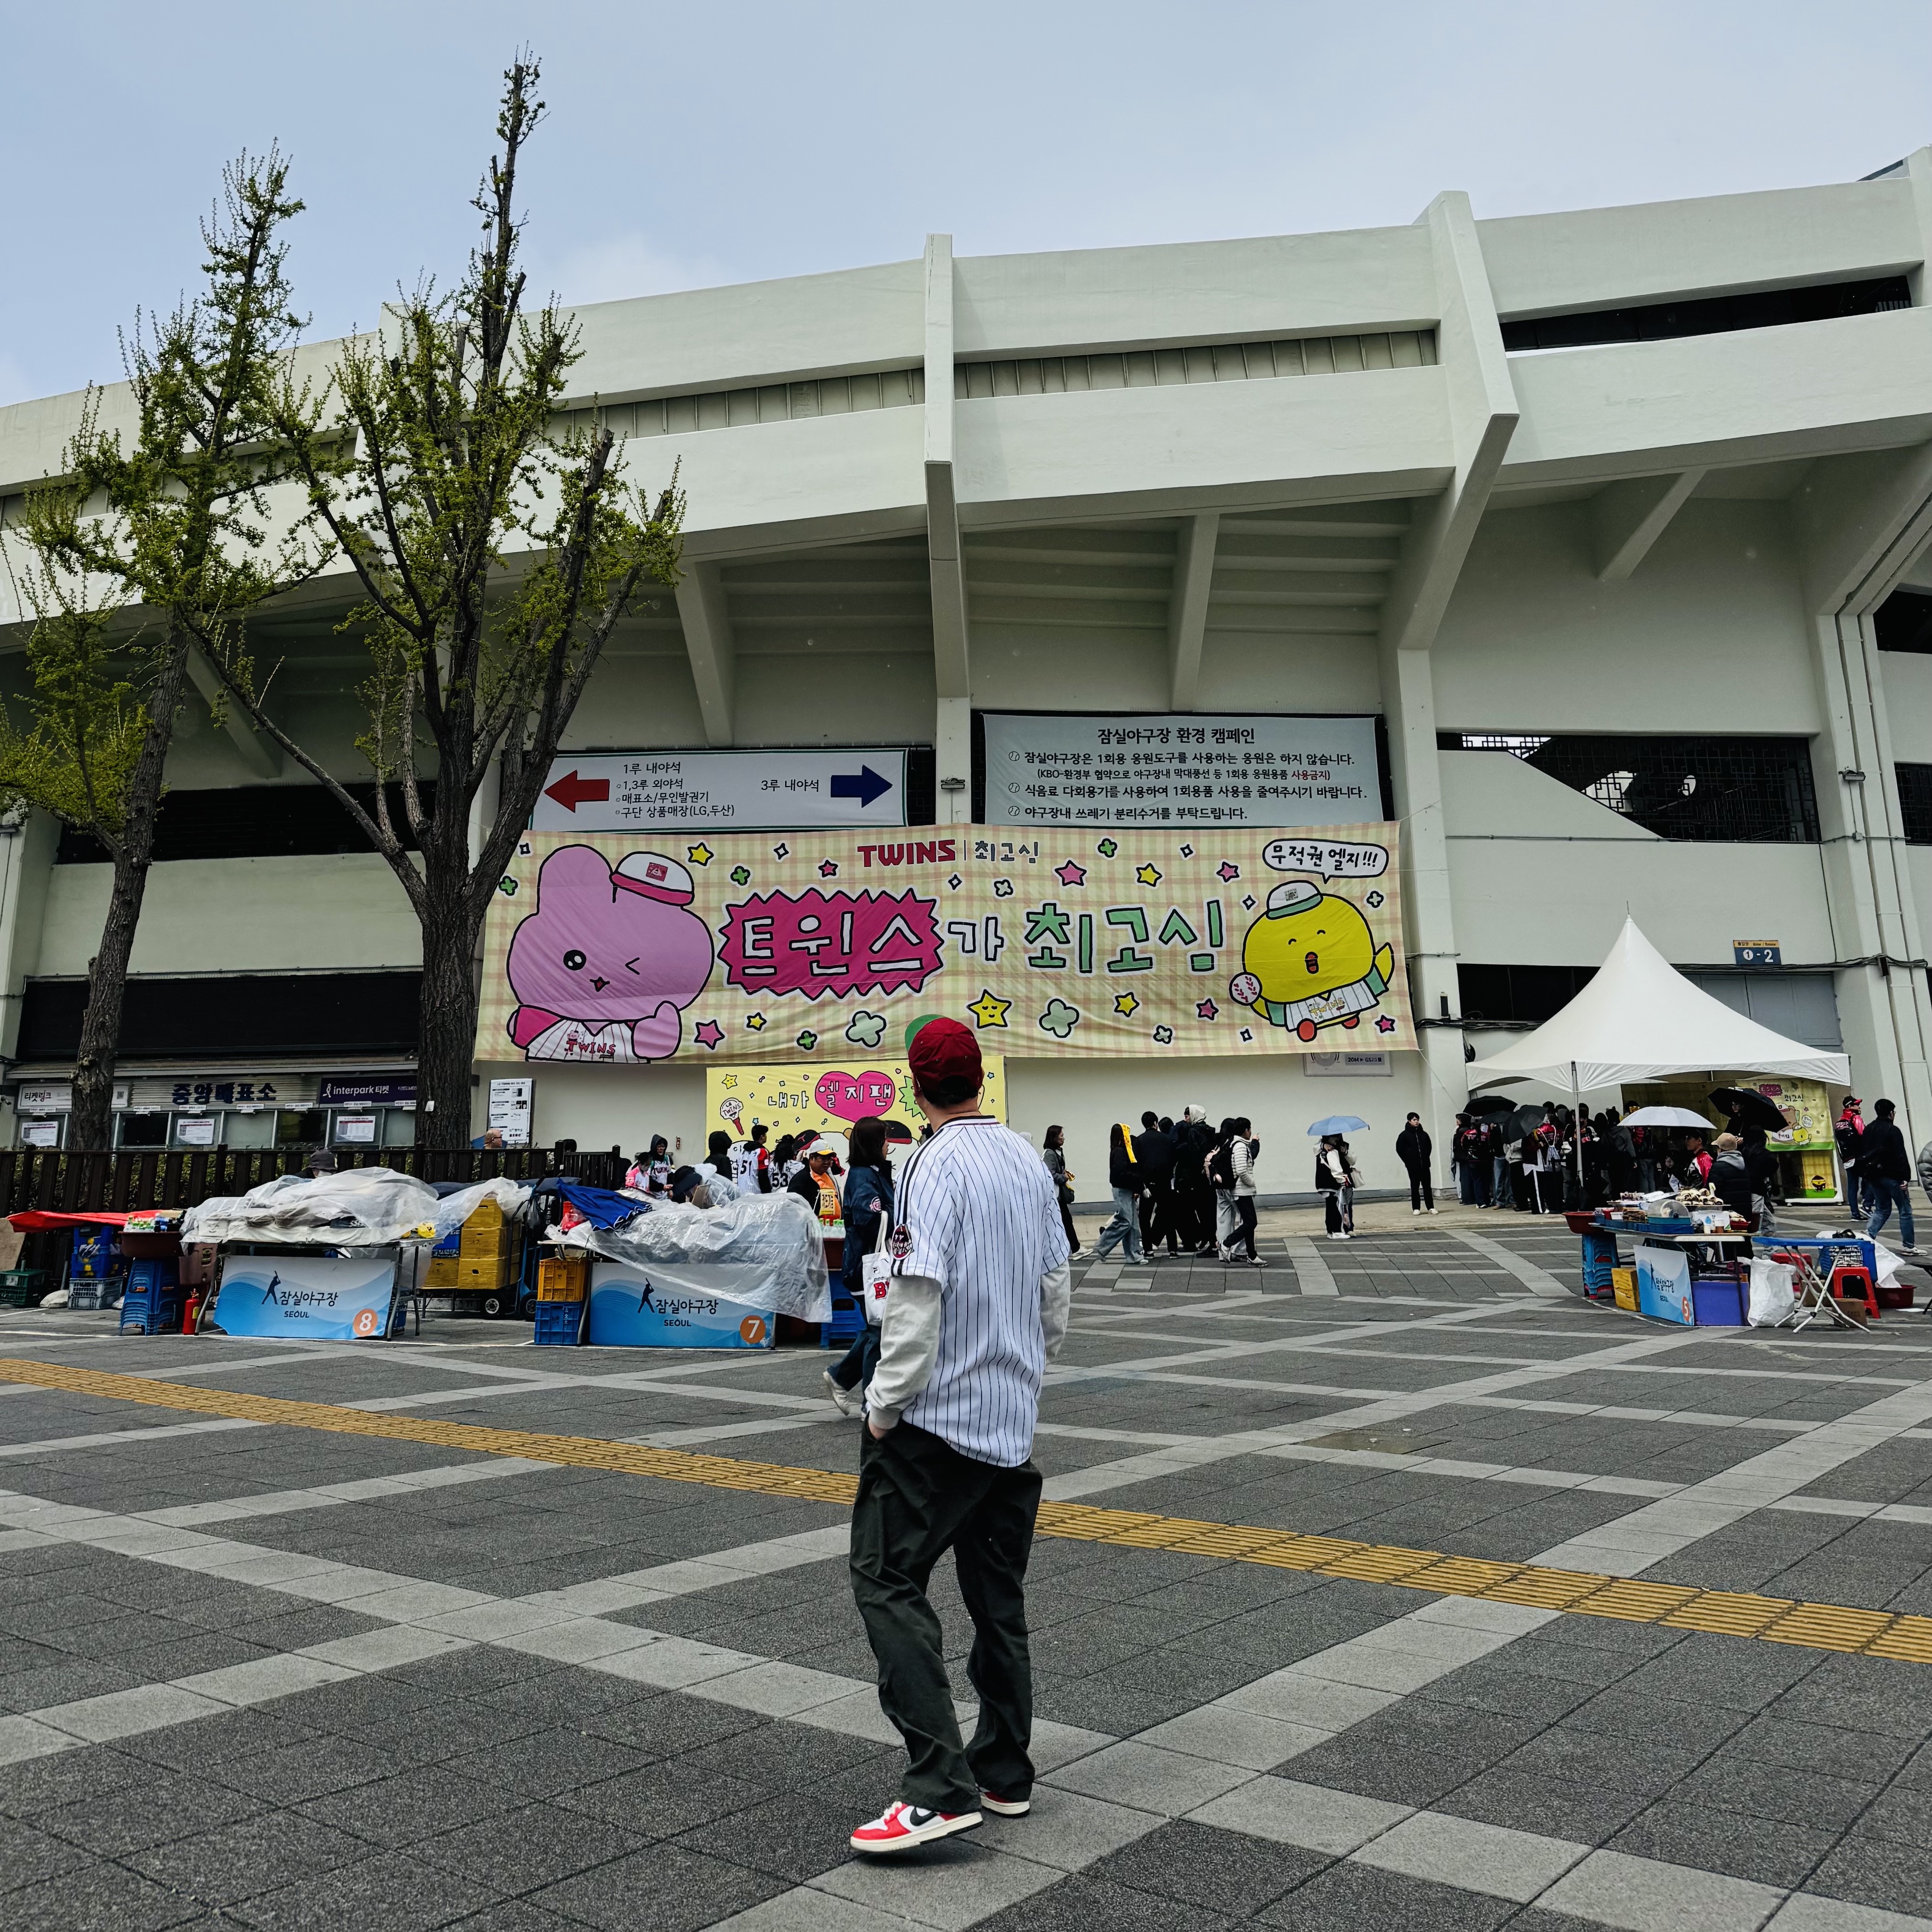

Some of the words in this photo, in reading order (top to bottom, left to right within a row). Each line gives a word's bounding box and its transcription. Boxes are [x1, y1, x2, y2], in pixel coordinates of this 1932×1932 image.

[1098, 728, 1171, 745] 잠실야구장
[1177, 728, 1205, 744] 환경
[1211, 728, 1255, 744] 캠페인
[1025, 752, 1093, 765] 잠실야구장은
[1098, 752, 1126, 765] 1회용
[1131, 752, 1188, 765] 응원도구를
[1192, 752, 1238, 765] 사용하는
[1242, 752, 1276, 765] 응원은
[1280, 753, 1301, 765] 하지
[1307, 753, 1354, 765] 않습니다.
[624, 763, 641, 774] 1루
[646, 762, 680, 774] 내야석
[1037, 768, 1091, 780] (KBO-환경부
[1094, 769, 1130, 780] 협약으로
[1134, 768, 1170, 780] 야구장내
[1174, 768, 1210, 780] 막대풍선
[1213, 768, 1222, 780] 등
[1226, 768, 1249, 780] 1회용
[1252, 768, 1288, 780] 응원용품
[1292, 770, 1330, 781] 사용금지)
[623, 780, 648, 791] 1,3루
[652, 778, 683, 789] 외야석
[761, 780, 780, 792] 3루
[785, 779, 819, 792] 내야석
[1025, 784, 1059, 797] 식음료
[1063, 785, 1120, 798] 다회용기를
[1123, 785, 1168, 798] 사용하여
[1173, 785, 1213, 798] 1회용품
[1218, 785, 1252, 798] 사용을
[1257, 785, 1312, 798] 줄여주시기
[1316, 786, 1367, 798] 바랍니다.
[622, 791, 708, 804] 매표소/무인발권기
[621, 806, 642, 818] 구단
[647, 804, 734, 818] 상품매장(LG,두산)
[1025, 807, 1071, 819] 야구장내
[1076, 808, 1110, 820] 쓰레기
[1114, 807, 1171, 820] 분리수거를
[1176, 807, 1247, 820] 부탁드립니다.
[857, 839, 956, 868] TWINS
[975, 841, 1038, 863] 최고심
[1271, 845, 1323, 867] 무적권
[1328, 848, 1378, 871] 엘지!!!
[1024, 899, 1224, 974] 최고심
[564, 1040, 616, 1054] TWINS
[172, 1082, 277, 1105] 중앙매표소
[334, 1085, 374, 1096] interpark
[375, 1085, 389, 1094] 티켓
[768, 1090, 809, 1109] 내가
[818, 1080, 892, 1108] 엘지팬
[722, 1103, 741, 1116] TWINS
[740, 1160, 752, 1176] 51
[772, 1172, 788, 1187] 53
[279, 1291, 338, 1307] 잠실야구장
[656, 1299, 719, 1315] 잠실야구장
[1684, 1300, 1688, 1316] 5
[359, 1312, 372, 1331] 8
[664, 1318, 691, 1327] SEOUL
[748, 1320, 759, 1339] 7
